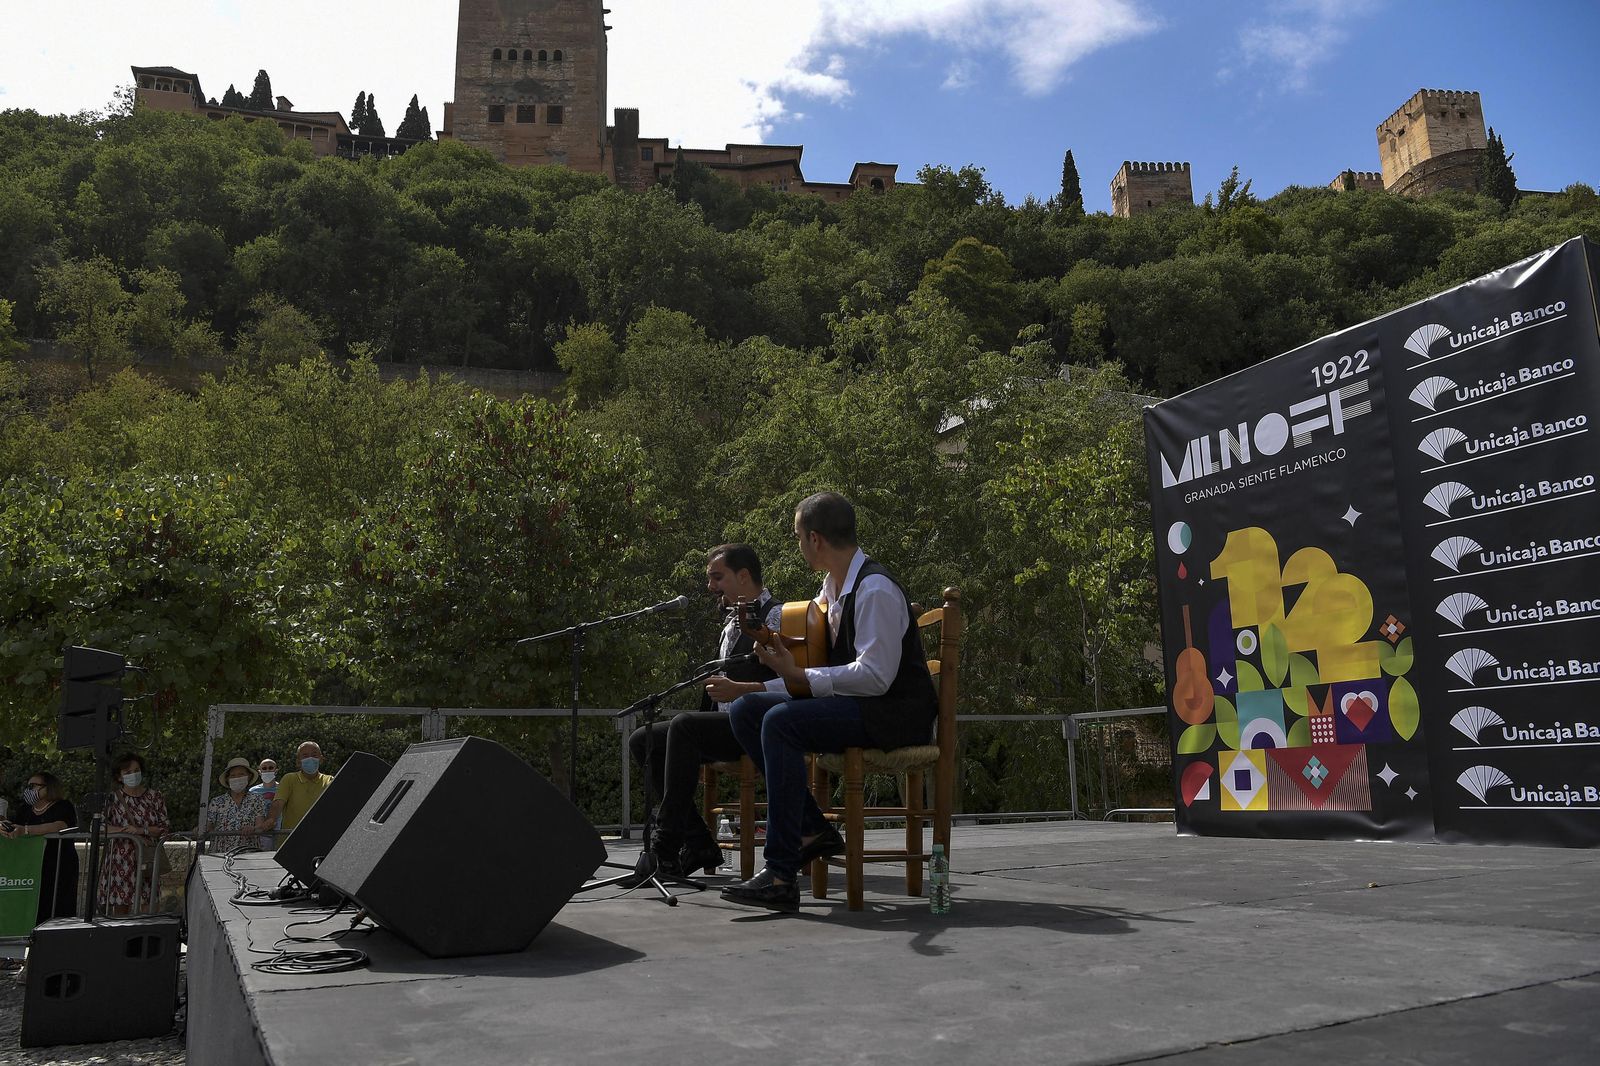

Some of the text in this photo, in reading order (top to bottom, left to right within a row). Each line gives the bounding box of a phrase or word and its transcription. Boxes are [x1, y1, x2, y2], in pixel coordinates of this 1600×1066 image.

[1449, 300, 1566, 348] Unicaja Banco
[1311, 349, 1370, 388] 1922
[1455, 358, 1574, 402] Unicaja Banco
[1465, 414, 1587, 454] Unicaja Banco
[1184, 447, 1347, 504] GRANADA SIENTE FLAMENCO
[1471, 474, 1595, 510] Unicaja Banco
[1480, 541, 1548, 566] Unicaja
[1486, 601, 1554, 624] Unicaja
[1496, 659, 1567, 681] Unicaja
[1502, 722, 1573, 743] Unicaja
[1510, 784, 1582, 806] Unicaja
[0, 876, 34, 887] Banco
